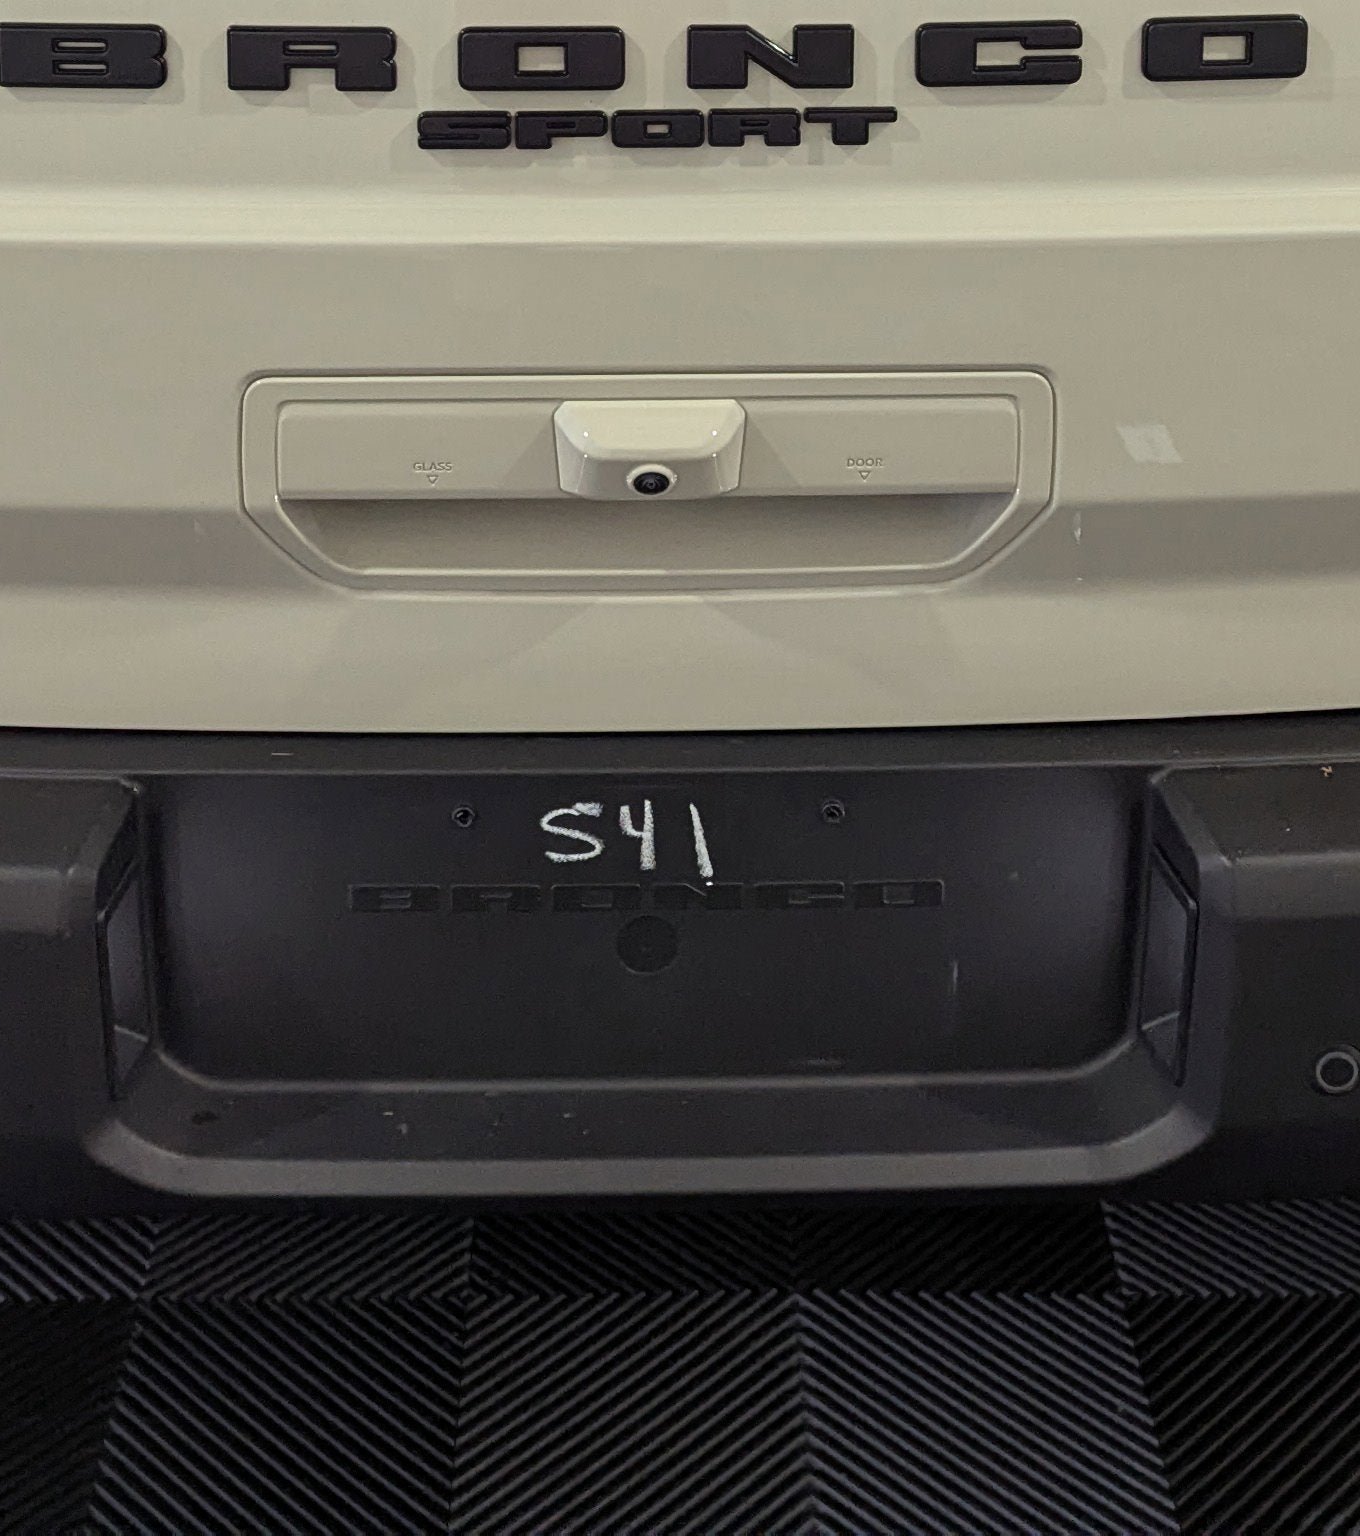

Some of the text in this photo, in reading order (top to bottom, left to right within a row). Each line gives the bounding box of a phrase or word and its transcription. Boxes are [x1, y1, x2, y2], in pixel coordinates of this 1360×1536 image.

[417, 105, 898, 150] SPORT
[412, 461, 453, 472] GLASS
[846, 457, 884, 468] DOOR
[348, 880, 945, 913] BRONCO
